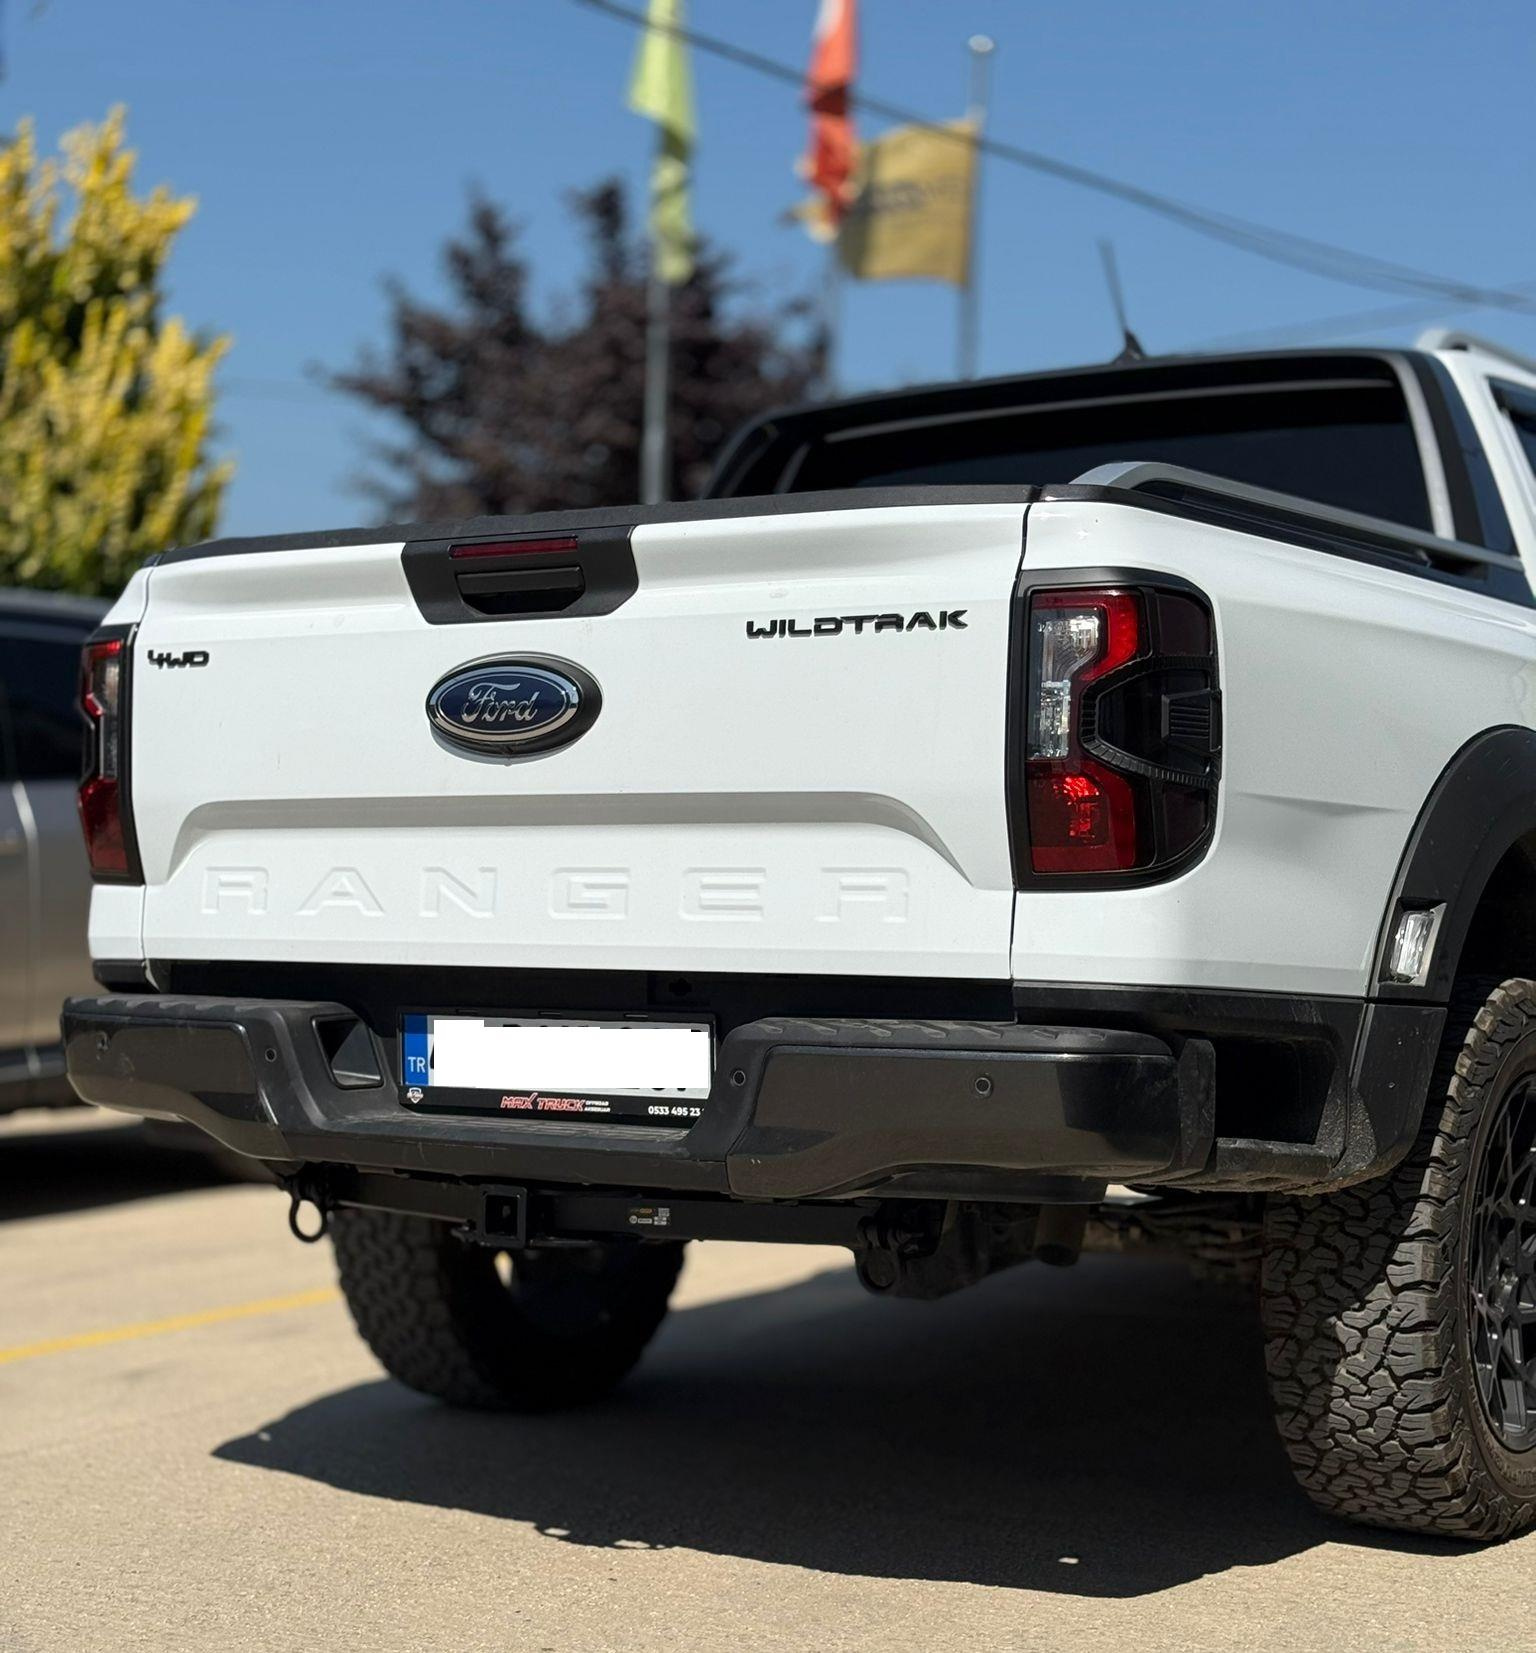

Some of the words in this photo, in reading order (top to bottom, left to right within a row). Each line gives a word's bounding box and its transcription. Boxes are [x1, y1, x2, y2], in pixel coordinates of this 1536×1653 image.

[746, 609, 968, 639] WILDTRAK
[147, 649, 210, 670] 4WD
[461, 682, 540, 723] Ford
[200, 866, 910, 923] RANGER
[407, 1056, 426, 1073] TR
[500, 1092, 538, 1109] MAX
[537, 1098, 585, 1111] TRUCK
[648, 1105, 670, 1115] 0533
[671, 1106, 689, 1116] 495
